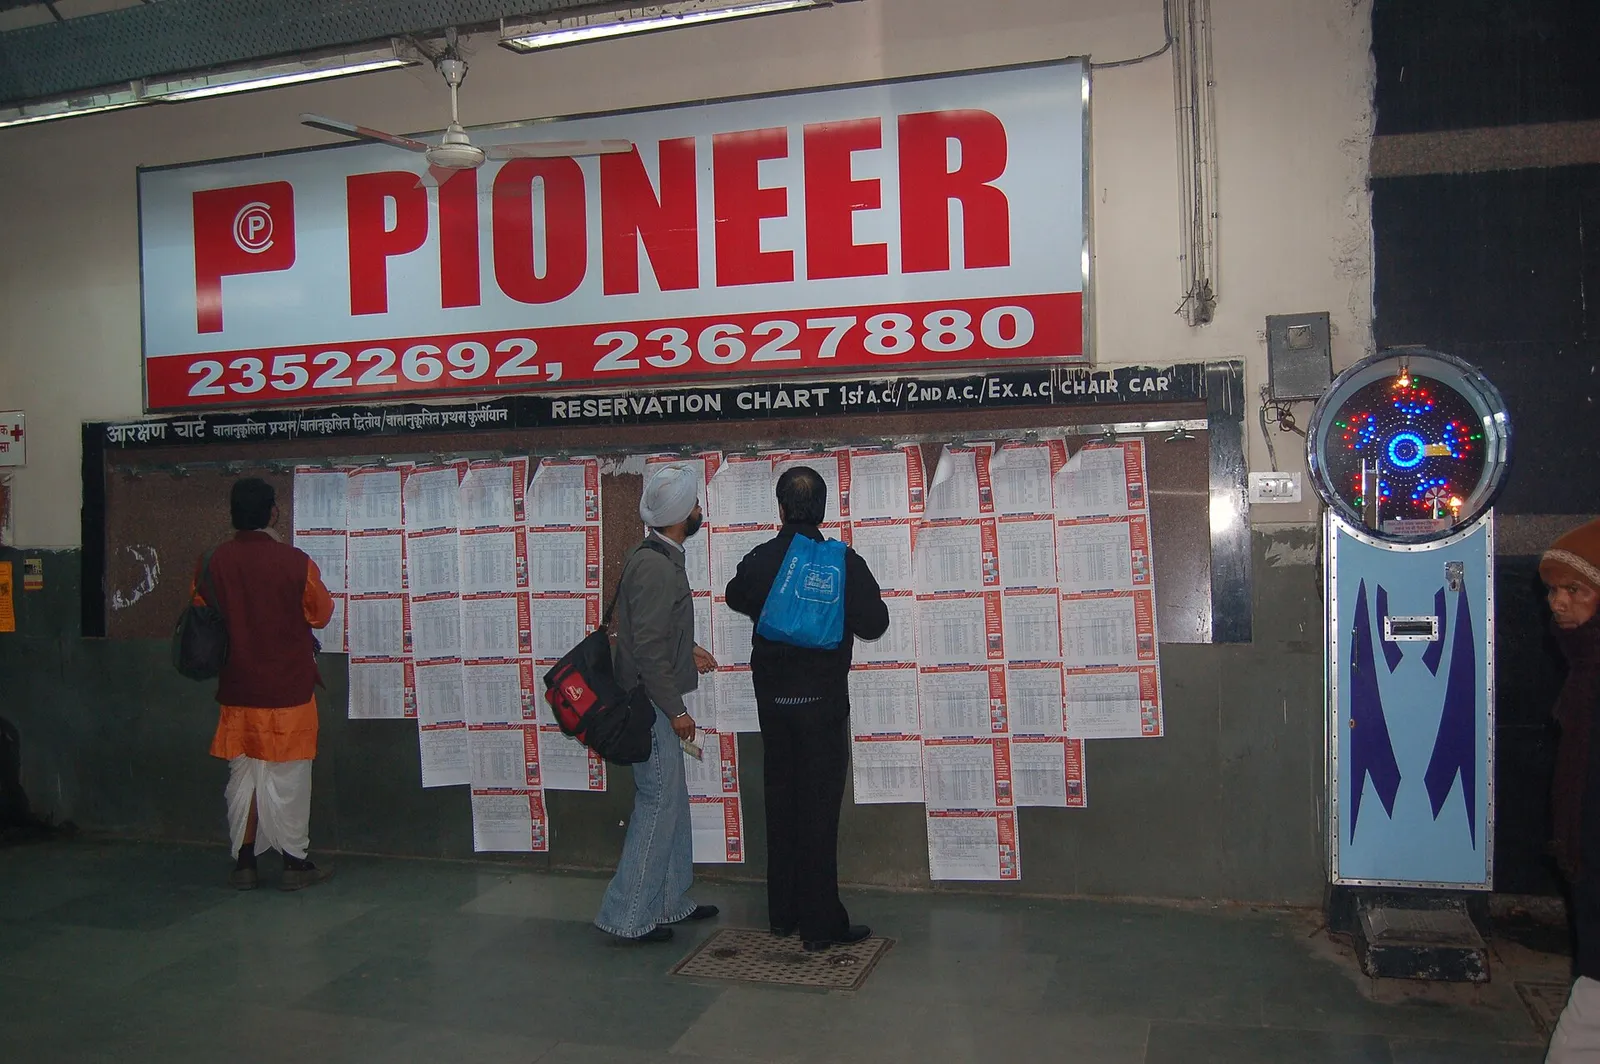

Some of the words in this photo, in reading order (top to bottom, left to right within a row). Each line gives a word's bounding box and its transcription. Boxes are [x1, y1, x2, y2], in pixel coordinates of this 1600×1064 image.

[347, 108, 1011, 316] PIONEER
[187, 336, 564, 398] 23522692,
[592, 304, 1036, 373] 23627880
[106, 421, 168, 443] आरक्षण
[212, 417, 267, 439] वातानुकूलित
[441, 411, 467, 427] प्रथम
[551, 392, 722, 419] RESERVATION
[736, 387, 830, 411] CHART
[839, 384, 864, 405] 1st
[1061, 379, 1119, 395] CHAIR
[1128, 376, 1169, 393] CAR
